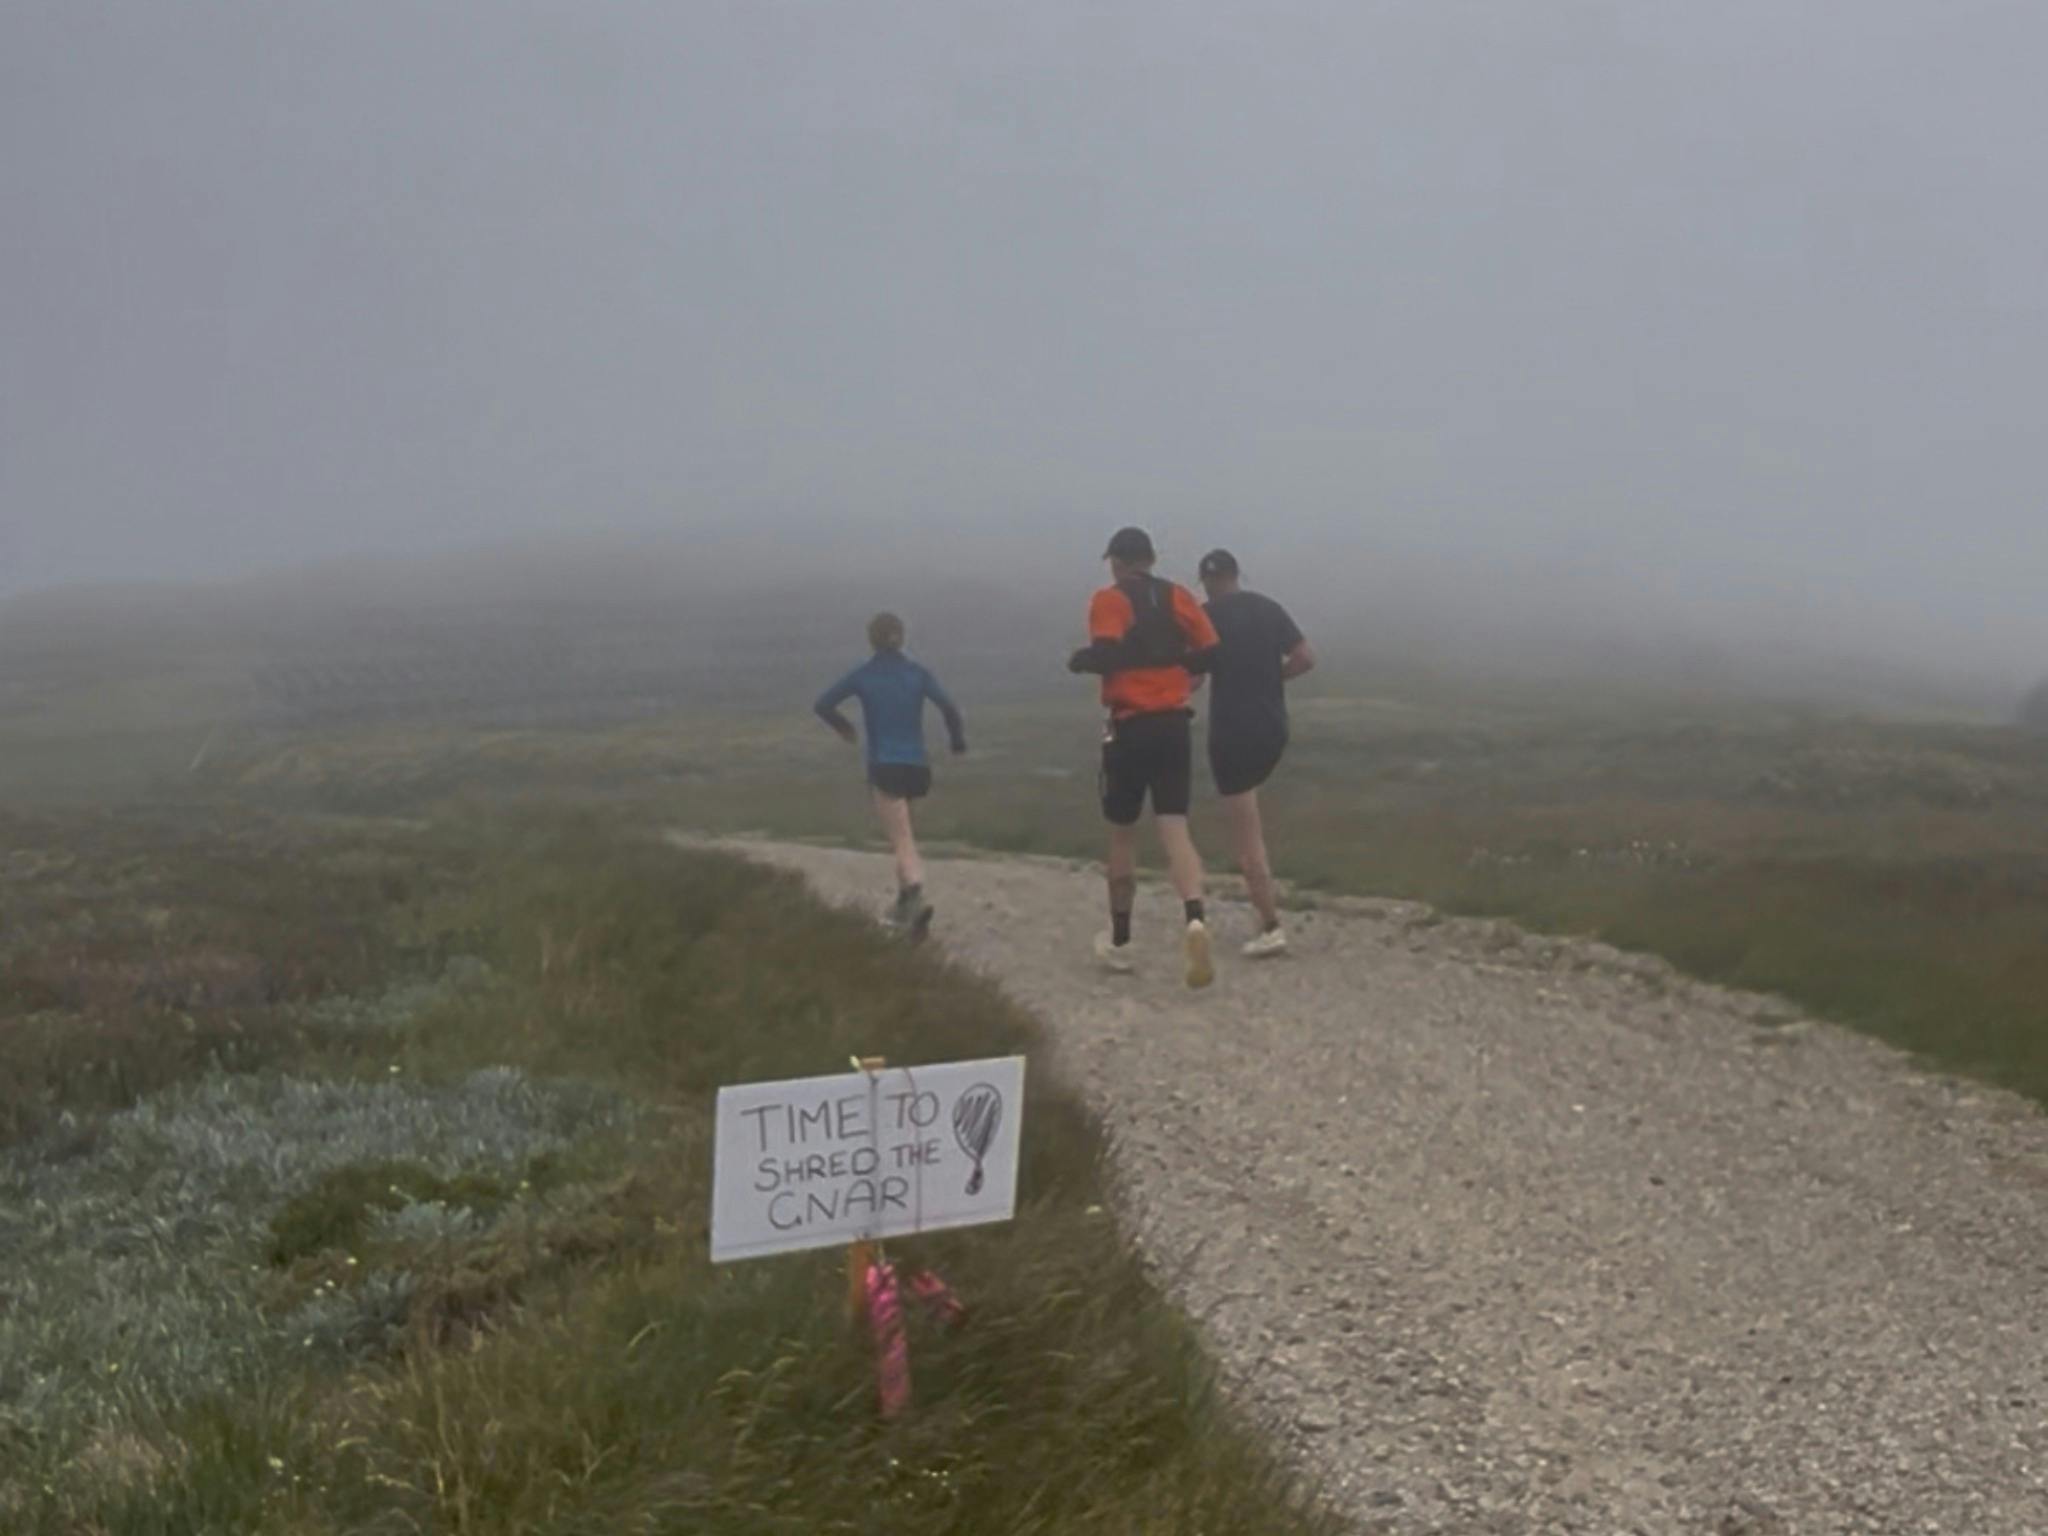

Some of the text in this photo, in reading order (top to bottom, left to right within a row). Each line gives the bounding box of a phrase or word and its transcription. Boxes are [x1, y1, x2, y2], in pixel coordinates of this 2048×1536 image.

[740, 1091, 940, 1151] TIME TO
[754, 1138, 942, 1192] SHRED THE
[768, 1176, 909, 1230] GNAR
